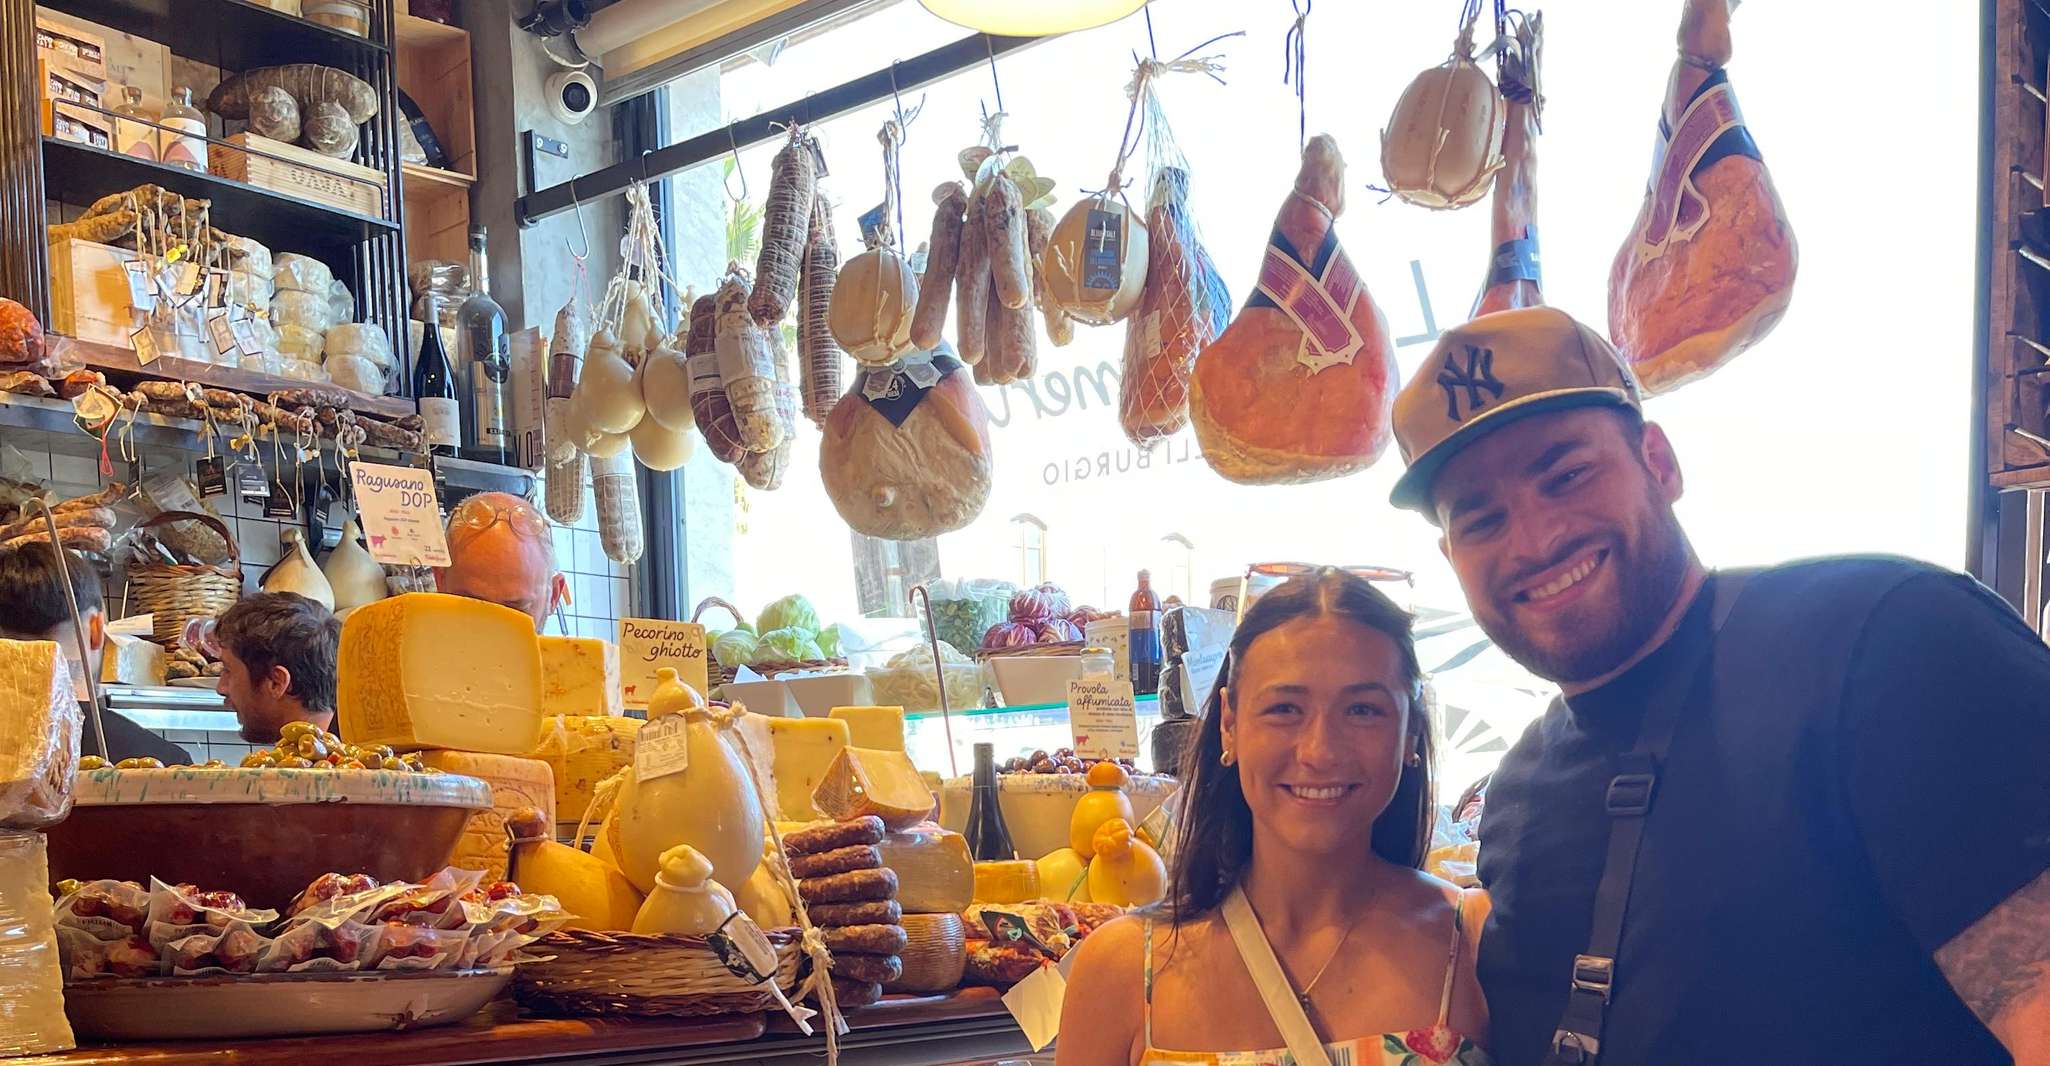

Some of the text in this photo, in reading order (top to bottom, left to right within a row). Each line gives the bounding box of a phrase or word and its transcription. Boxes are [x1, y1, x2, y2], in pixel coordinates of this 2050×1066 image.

[1437, 344, 1505, 421] NY
[356, 468, 424, 493] Ragusano
[401, 490, 433, 508] DOP
[623, 622, 685, 641] Pecorino
[642, 641, 704, 662] ghiotto
[1070, 682, 1109, 694] Provola
[1076, 694, 1131, 710] affumicata
